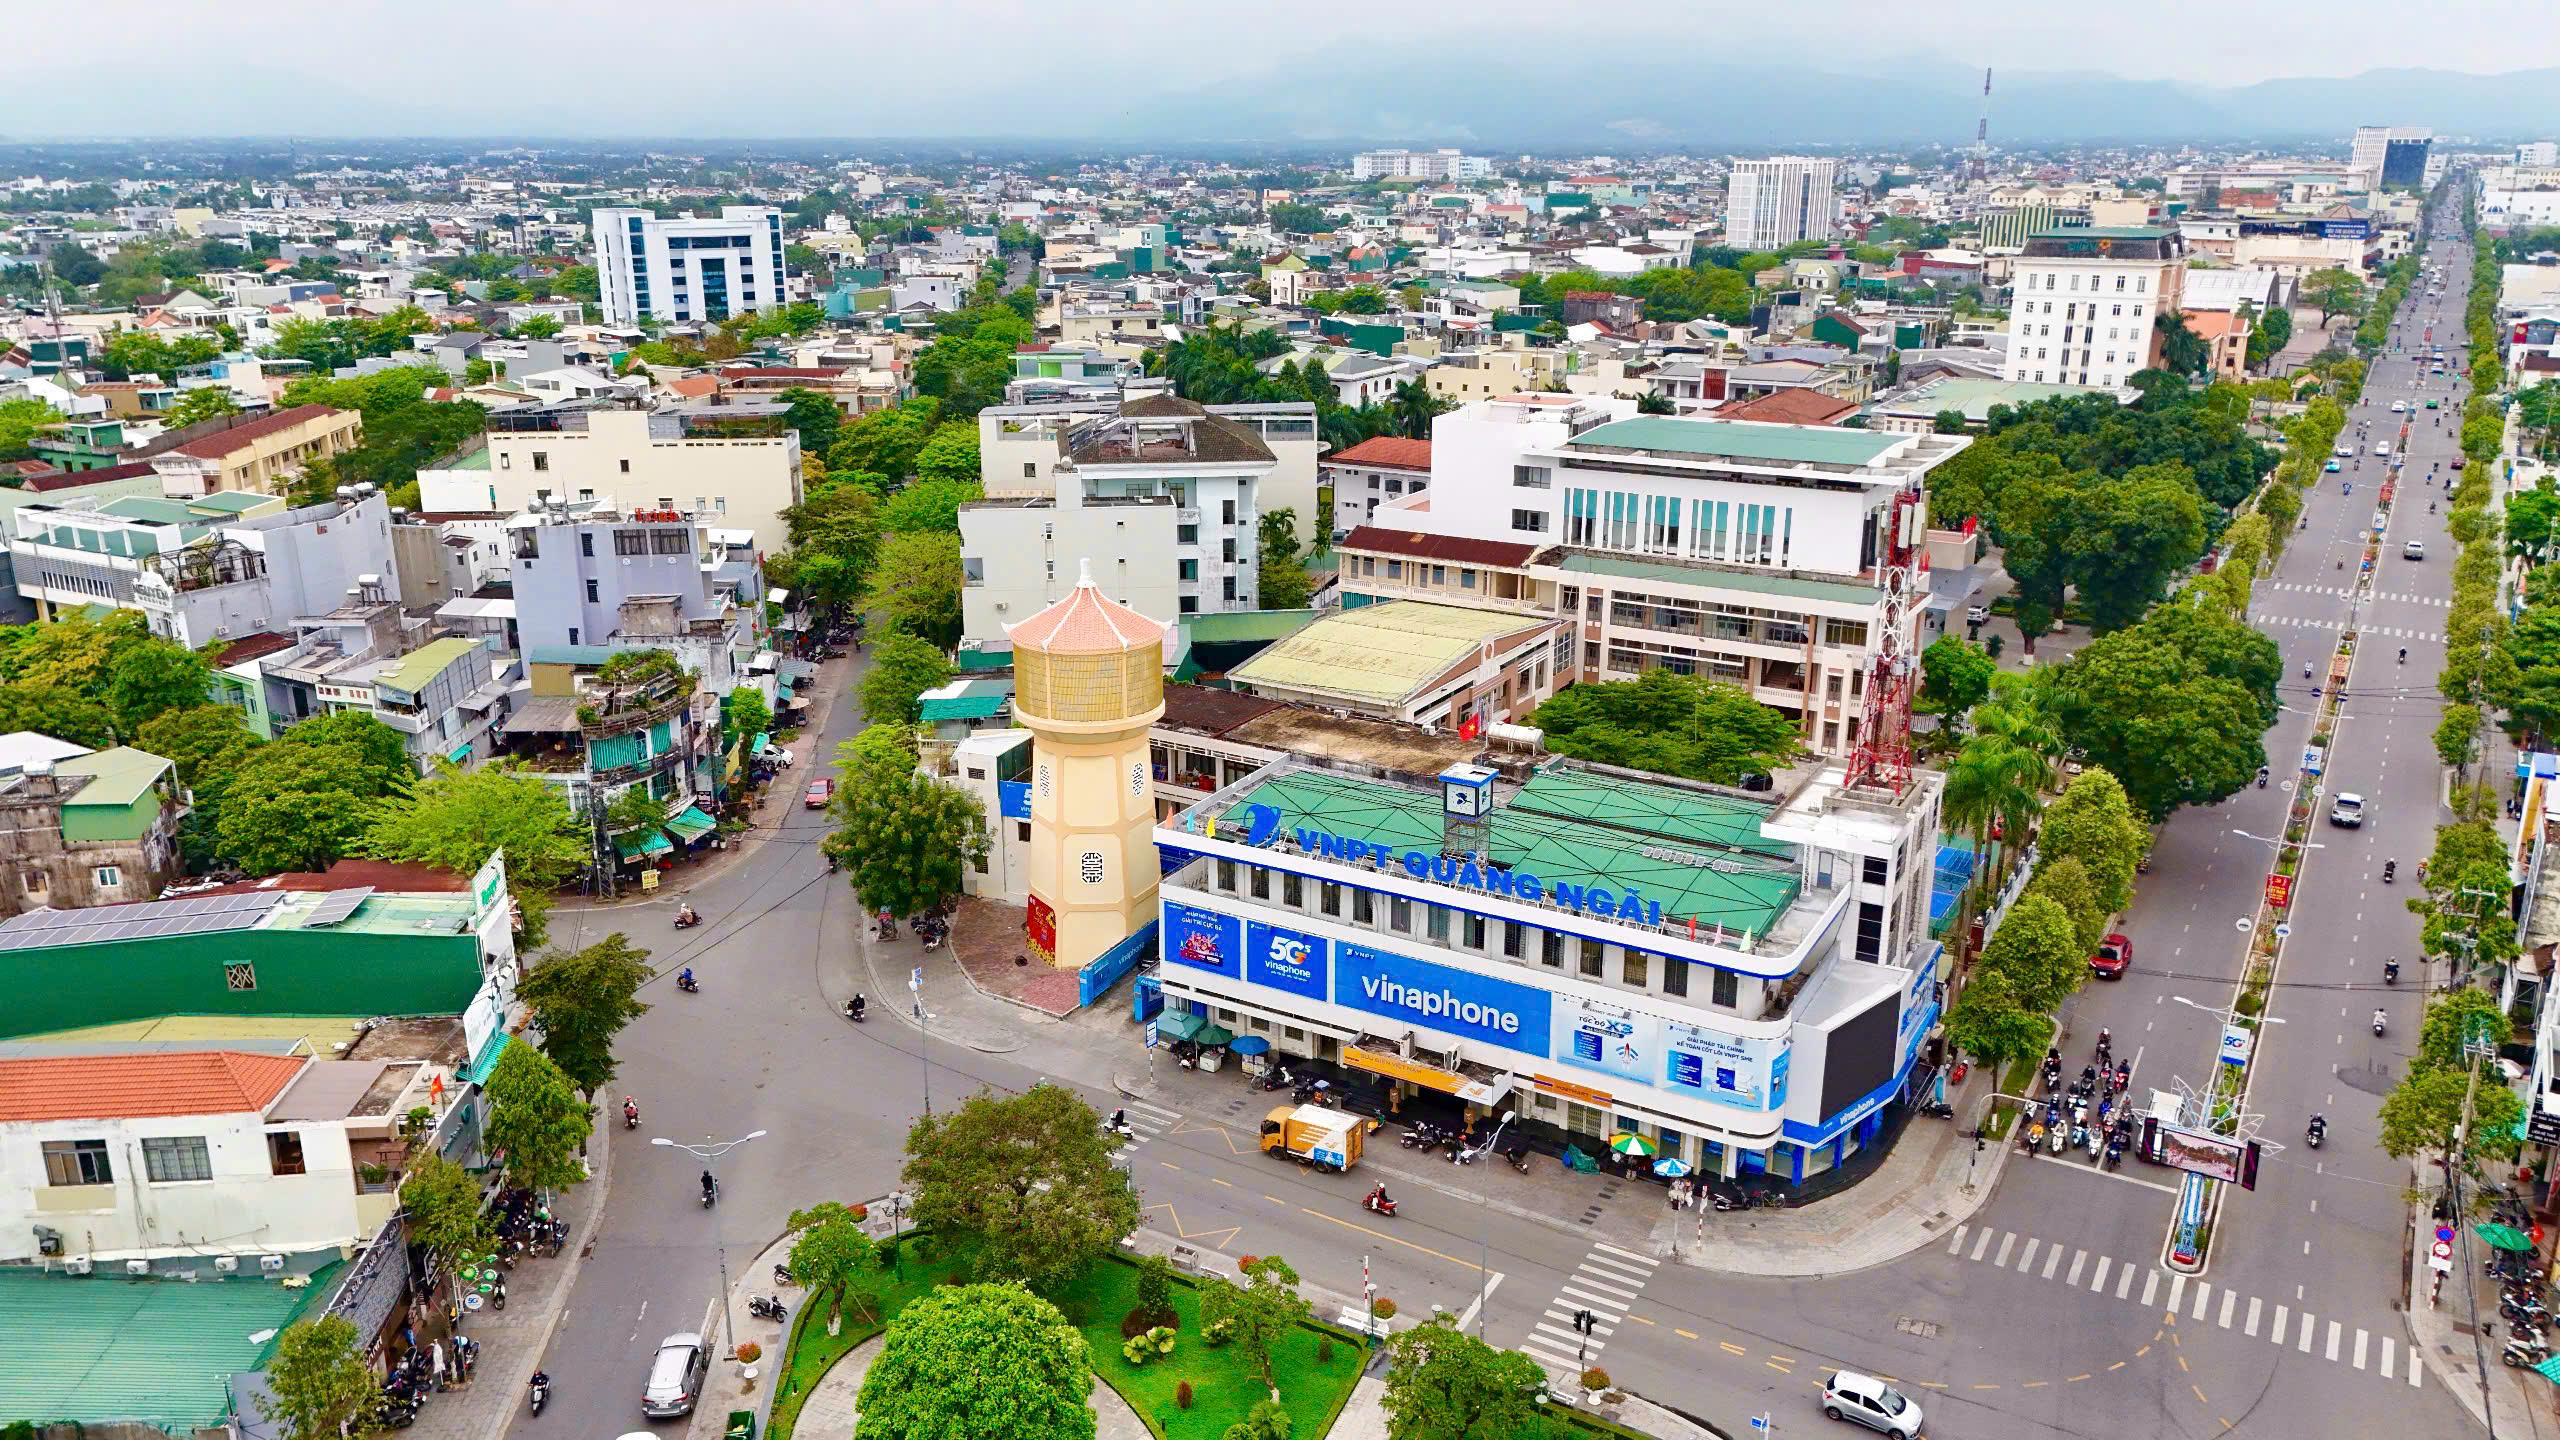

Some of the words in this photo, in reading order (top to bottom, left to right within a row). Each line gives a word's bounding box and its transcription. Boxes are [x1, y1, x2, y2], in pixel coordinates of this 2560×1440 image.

[1296, 826, 1392, 869] VNPT
[1404, 849, 1543, 900] QUẢNG
[1556, 881, 1660, 926] NGÃI
[1354, 950, 1375, 960] VNPT
[1265, 959, 1311, 978] vinaphone
[1361, 974, 1519, 1033] vinaphone
[1723, 1051, 1740, 1060] VNPT
[1839, 1097, 1875, 1126] vinaphone
